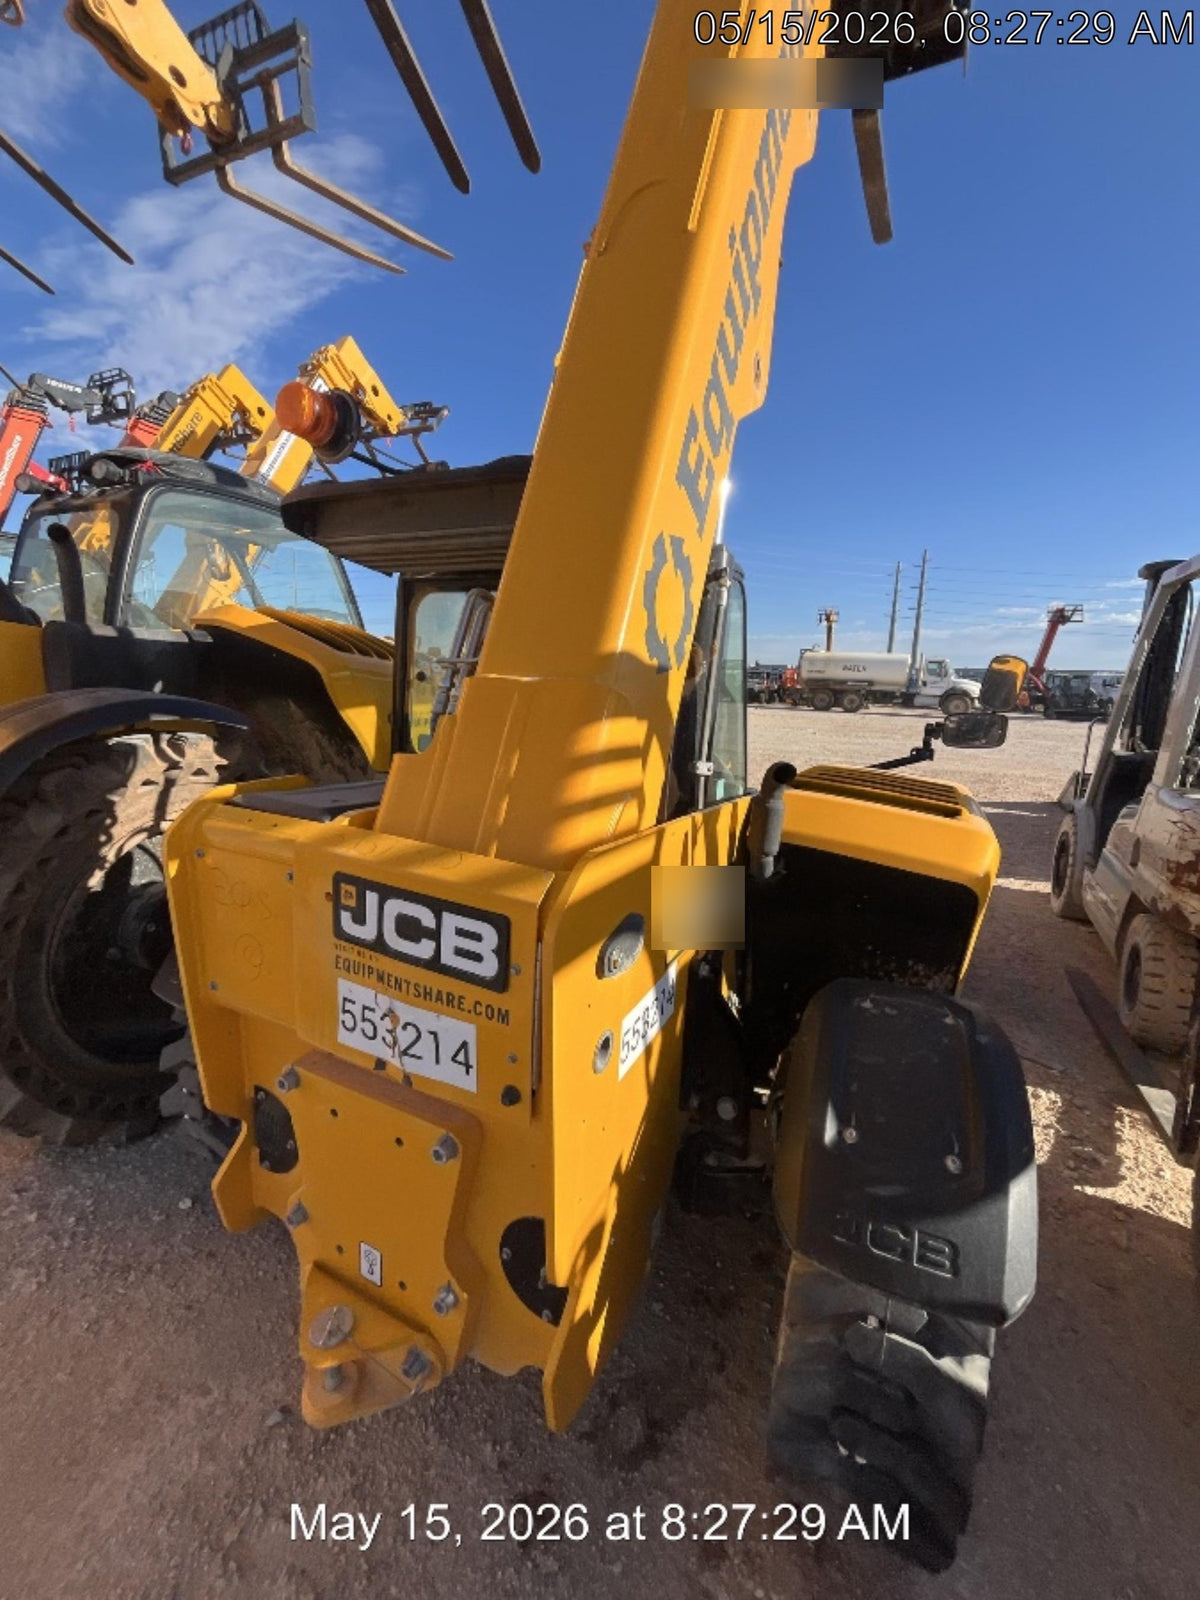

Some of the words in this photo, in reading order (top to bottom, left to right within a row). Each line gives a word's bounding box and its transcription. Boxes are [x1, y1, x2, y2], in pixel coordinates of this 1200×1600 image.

[340, 889, 499, 980] JCB
[335, 954, 510, 1026] EQUIPMENTSHARE.COM
[340, 996, 474, 1076] 553214
